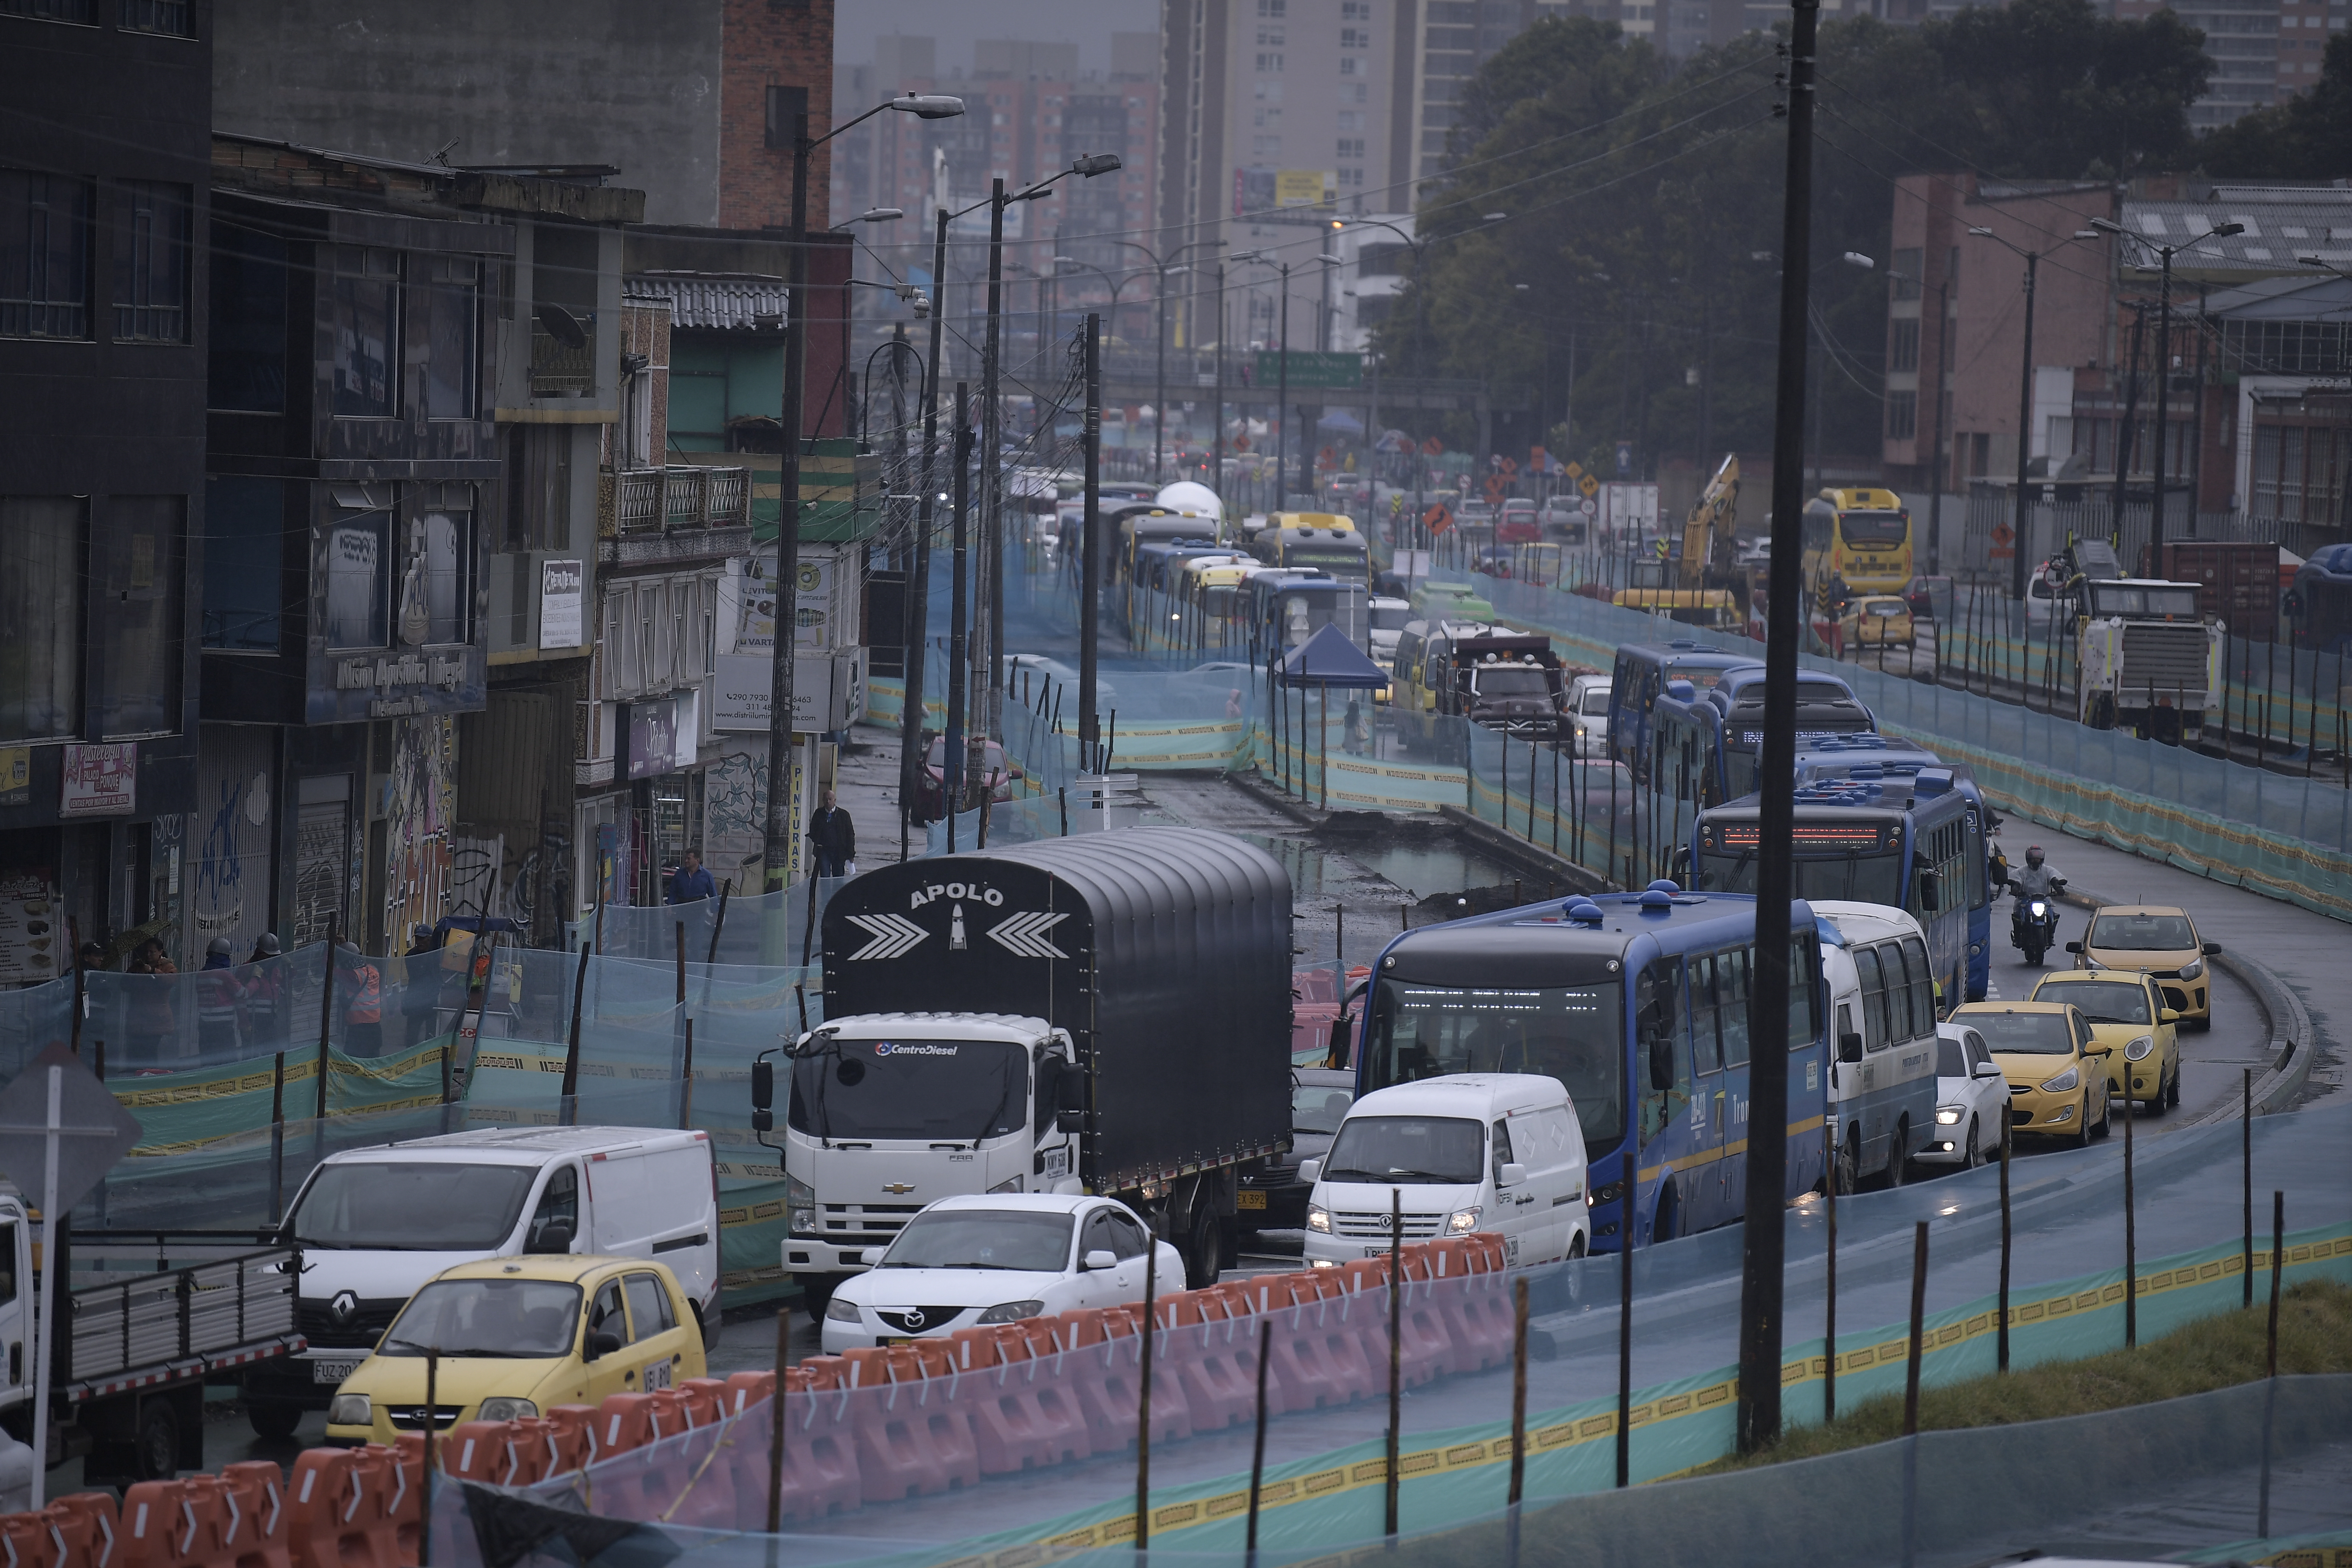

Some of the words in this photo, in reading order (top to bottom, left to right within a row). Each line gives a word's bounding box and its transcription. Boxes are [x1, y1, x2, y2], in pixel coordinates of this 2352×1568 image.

[84, 769, 99, 781] PALACIO
[100, 773, 119, 789] PONQUE
[70, 798, 85, 808] VENTAS
[792, 767, 801, 869] PINTURAS
[911, 882, 1004, 910] APOLO
[891, 1044, 958, 1056] CentroDiesel
[1249, 1194, 1265, 1204] 392
[316, 1365, 335, 1377] FUZ
